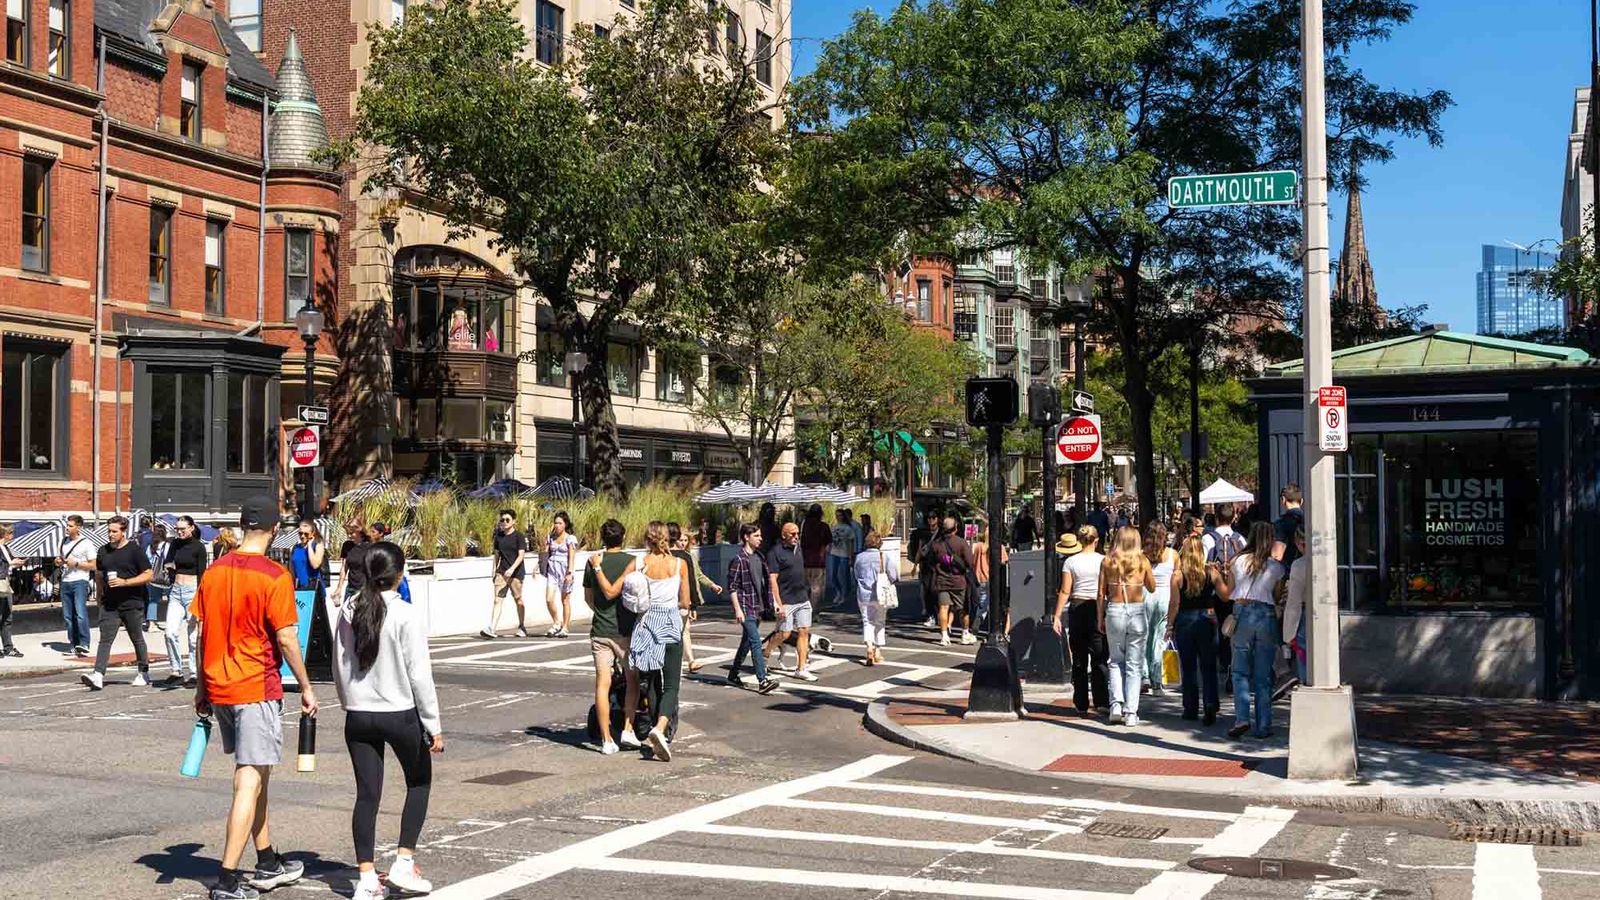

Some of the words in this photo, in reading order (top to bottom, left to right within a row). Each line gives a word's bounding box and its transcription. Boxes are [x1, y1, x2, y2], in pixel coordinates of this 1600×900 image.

[1172, 176, 1274, 204] DARTMOUTH
[1284, 186, 1294, 199] ST
[1412, 407, 1441, 421] 144
[1063, 427, 1074, 435] DO
[1077, 426, 1094, 434] NOT
[1326, 434, 1341, 442] SNOW
[1065, 444, 1092, 453] ENTER
[1425, 478, 1504, 499] LUSH
[1425, 501, 1504, 519] FRESH
[1425, 521, 1505, 533] HANDMADE
[1426, 534, 1505, 546] COSMETICS
